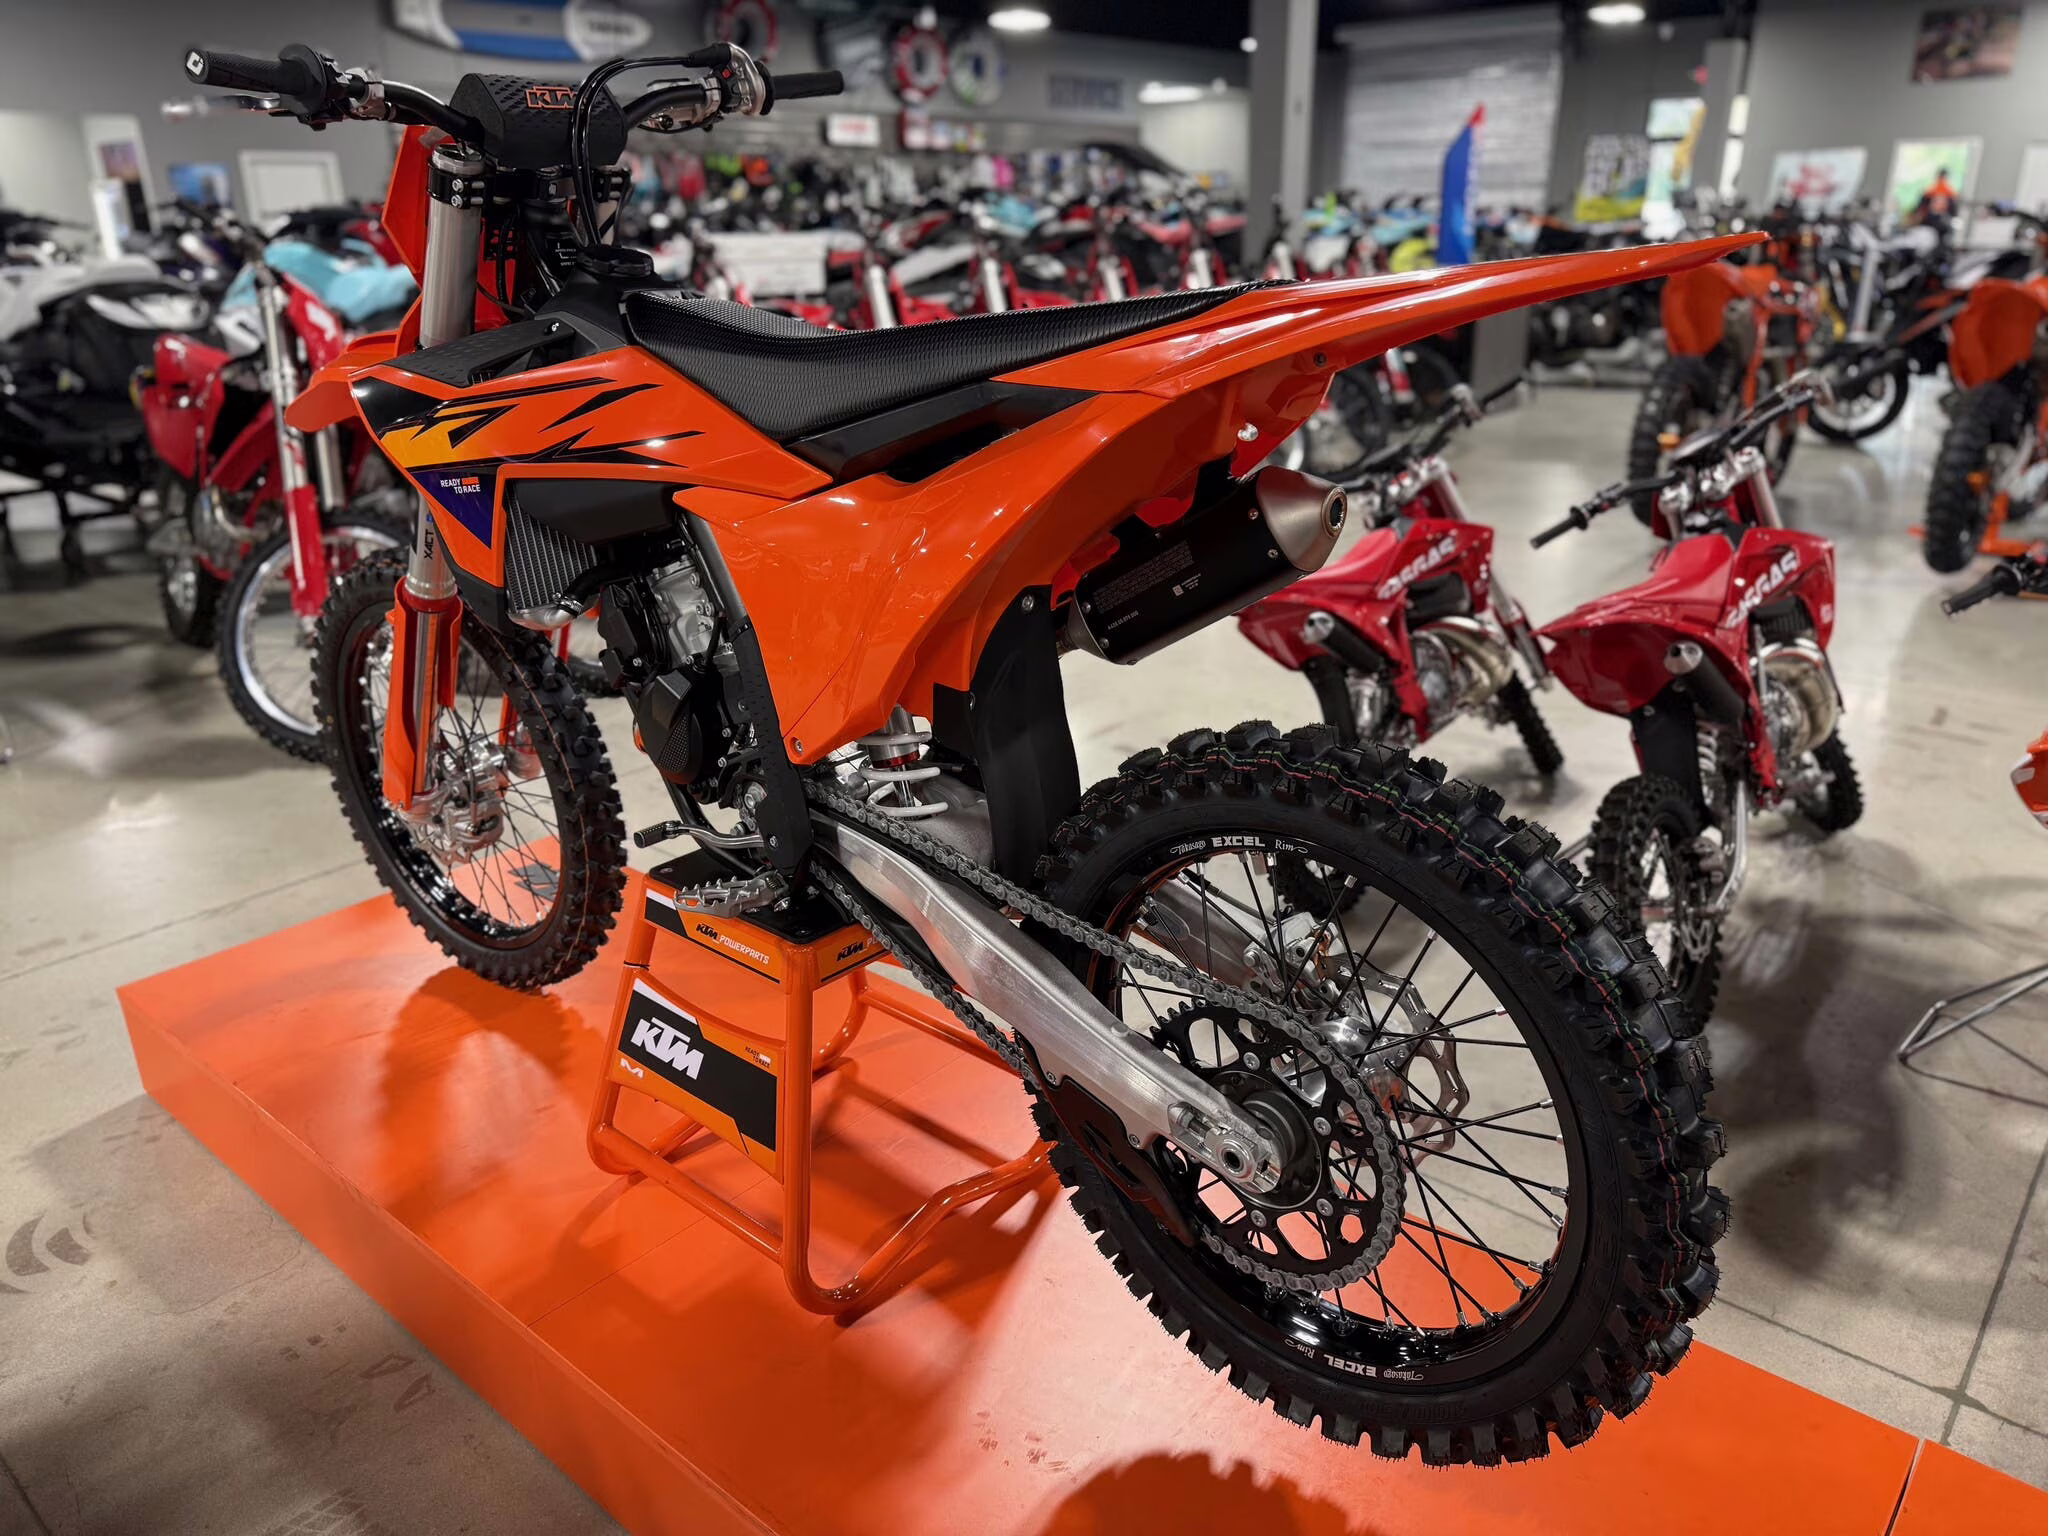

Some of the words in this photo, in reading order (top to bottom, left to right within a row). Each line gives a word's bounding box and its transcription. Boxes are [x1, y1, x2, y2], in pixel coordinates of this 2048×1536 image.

[440, 479, 460, 487] READY
[462, 484, 481, 493] RACE
[424, 529, 434, 560] XACT
[1210, 835, 1266, 848] EXCEL
[1274, 839, 1308, 854] Rim
[696, 922, 719, 940] KTM
[630, 1016, 705, 1081] KTM
[1284, 1338, 1316, 1359] Rim
[1323, 1353, 1377, 1378] EXCEL
